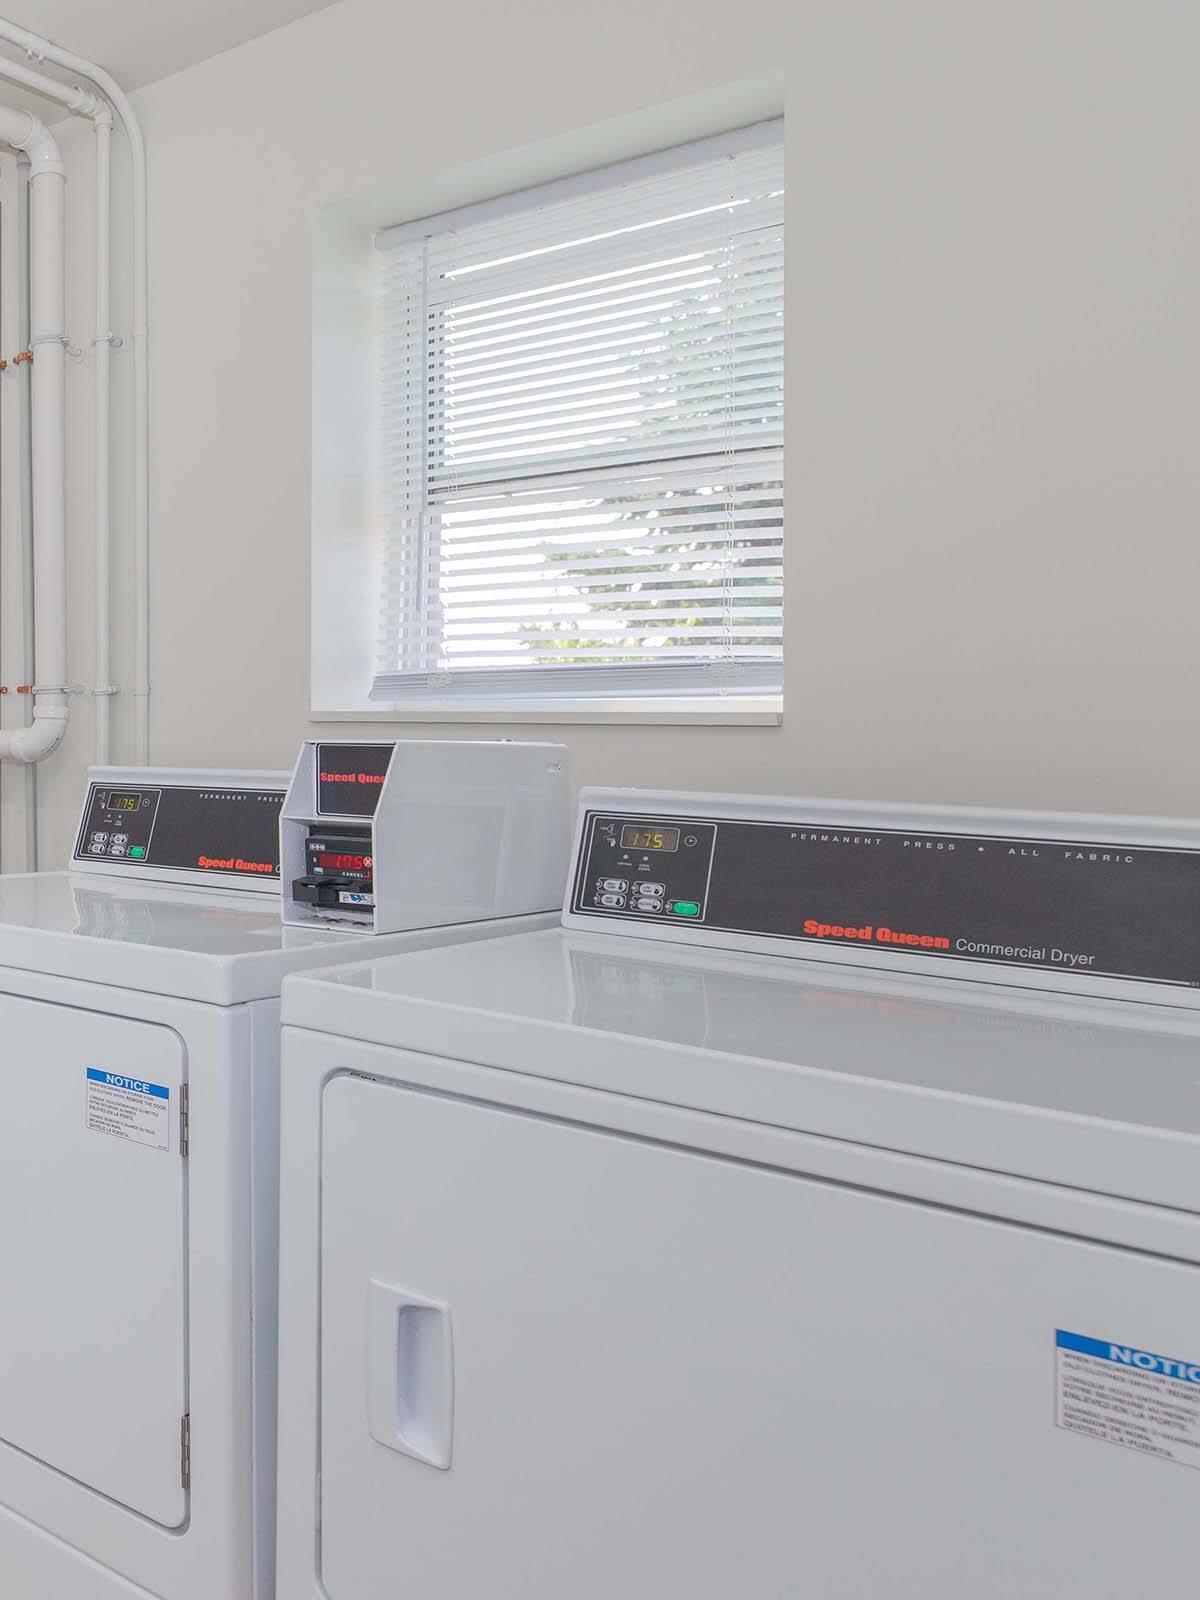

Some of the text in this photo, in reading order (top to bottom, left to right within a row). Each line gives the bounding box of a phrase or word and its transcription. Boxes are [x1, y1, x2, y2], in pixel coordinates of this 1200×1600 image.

[320, 771, 356, 783] Speed
[199, 793, 247, 801] PERMANENT
[631, 833, 664, 849] 175
[790, 832, 1134, 864] PERMANENT PRESS ALL FABRIC
[198, 855, 234, 869] Speed
[235, 858, 273, 873] Queen
[803, 919, 1095, 966] Speed Queen Commercial Dryer
[106, 1073, 151, 1094] NOTICE
[1109, 1344, 1200, 1383] NOTIC
